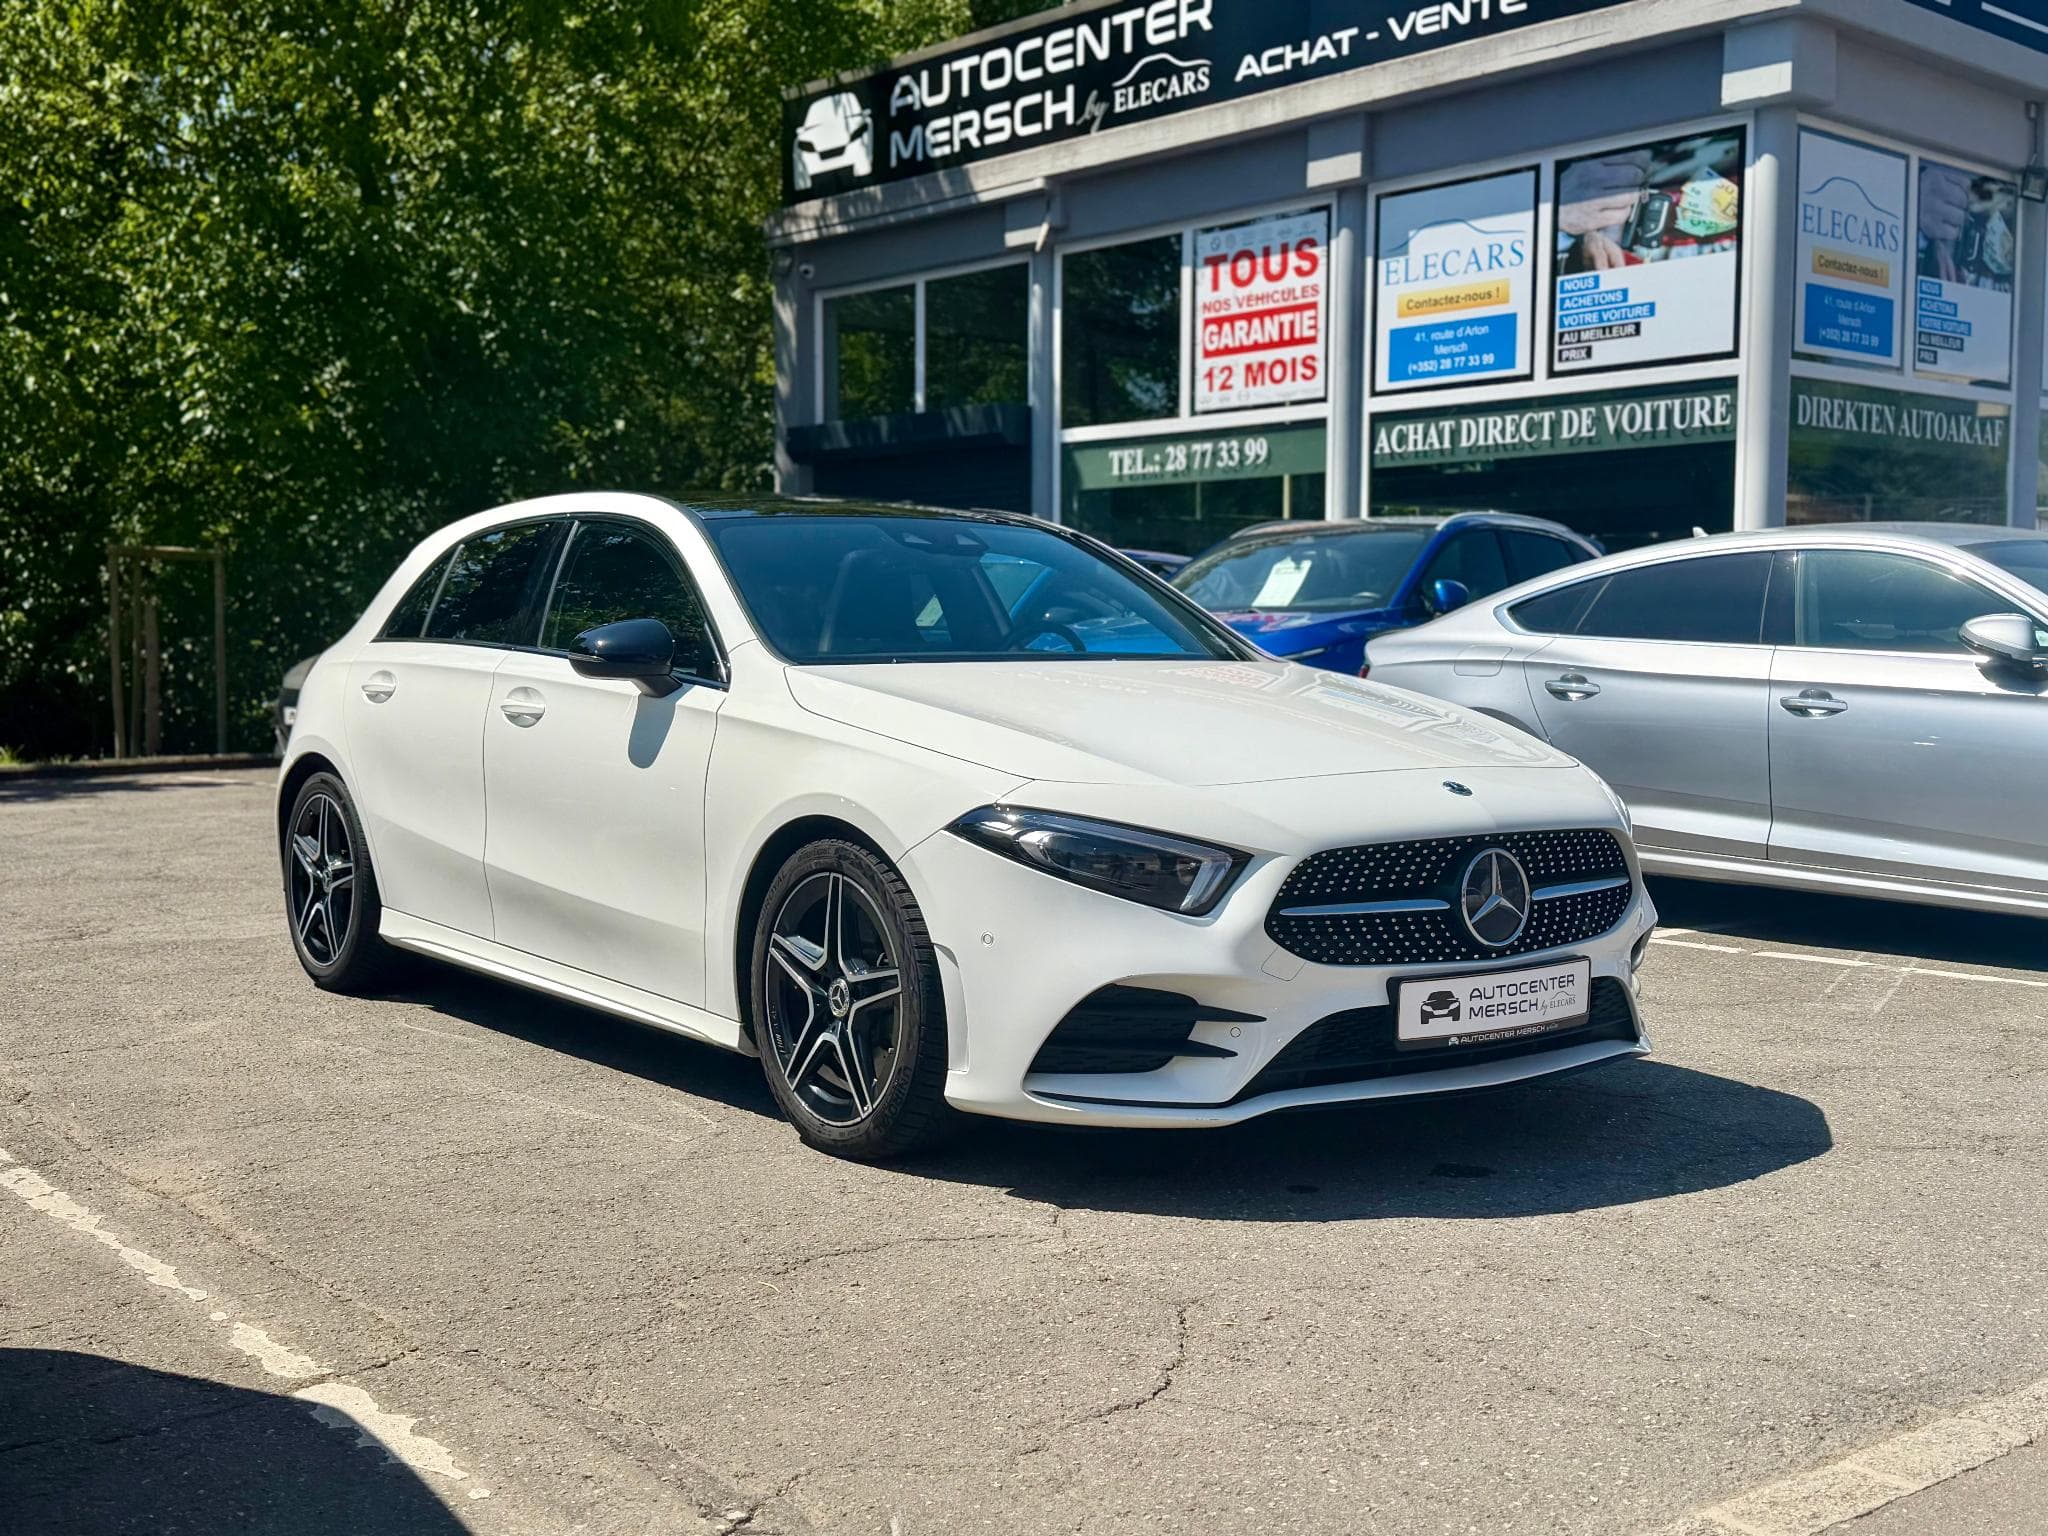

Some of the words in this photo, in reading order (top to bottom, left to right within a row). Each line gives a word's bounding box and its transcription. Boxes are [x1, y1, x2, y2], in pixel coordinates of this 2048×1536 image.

[889, 0, 1213, 117] AUTOCENTER
[1234, 27, 1359, 82] ACHAT
[889, 84, 1075, 168] MERSCH
[1076, 90, 1109, 135] by
[1113, 66, 1211, 115] ELECARS
[1801, 202, 1900, 251] ELECARS
[1203, 237, 1320, 292] TOUS
[1384, 239, 1525, 287] ELECARS
[1563, 277, 1595, 291] NOUS
[1202, 297, 1231, 314] NOS
[1236, 284, 1320, 309] VEHICULES
[1405, 289, 1493, 311] Contactez-nous
[1563, 290, 1624, 309] ACHETONS
[1562, 312, 1600, 326] VOTRE
[1601, 304, 1651, 321] VOITURE
[1203, 310, 1317, 352] GARANTIE
[1430, 329, 1455, 341] route
[1561, 331, 1579, 344] AU
[1580, 324, 1636, 341] MEILLEUR
[1433, 342, 1469, 355] Mersch
[1454, 356, 1466, 368] 77
[1561, 348, 1588, 361] PRIX
[1203, 365, 1234, 392] 12
[1244, 354, 1318, 388] MOIS
[1374, 420, 1455, 455] ACHAT
[1459, 411, 1556, 448] DIRECT
[1560, 406, 1597, 440] DE
[1603, 394, 1732, 435] VOITURE
[1797, 394, 1896, 436] DIREKTEN
[1901, 407, 2005, 448] AUTOAKAAF
[1165, 444, 1187, 471] 28
[1191, 442, 1213, 469] 77
[1216, 440, 1239, 468] 33
[1244, 437, 1268, 464] 99
[1469, 974, 1575, 1001] AUTOCENTER
[1469, 998, 1539, 1019] MERSCH
[1460, 1030, 1515, 1044] AUTOCENTER
[1516, 1024, 1546, 1037] MERSCH
